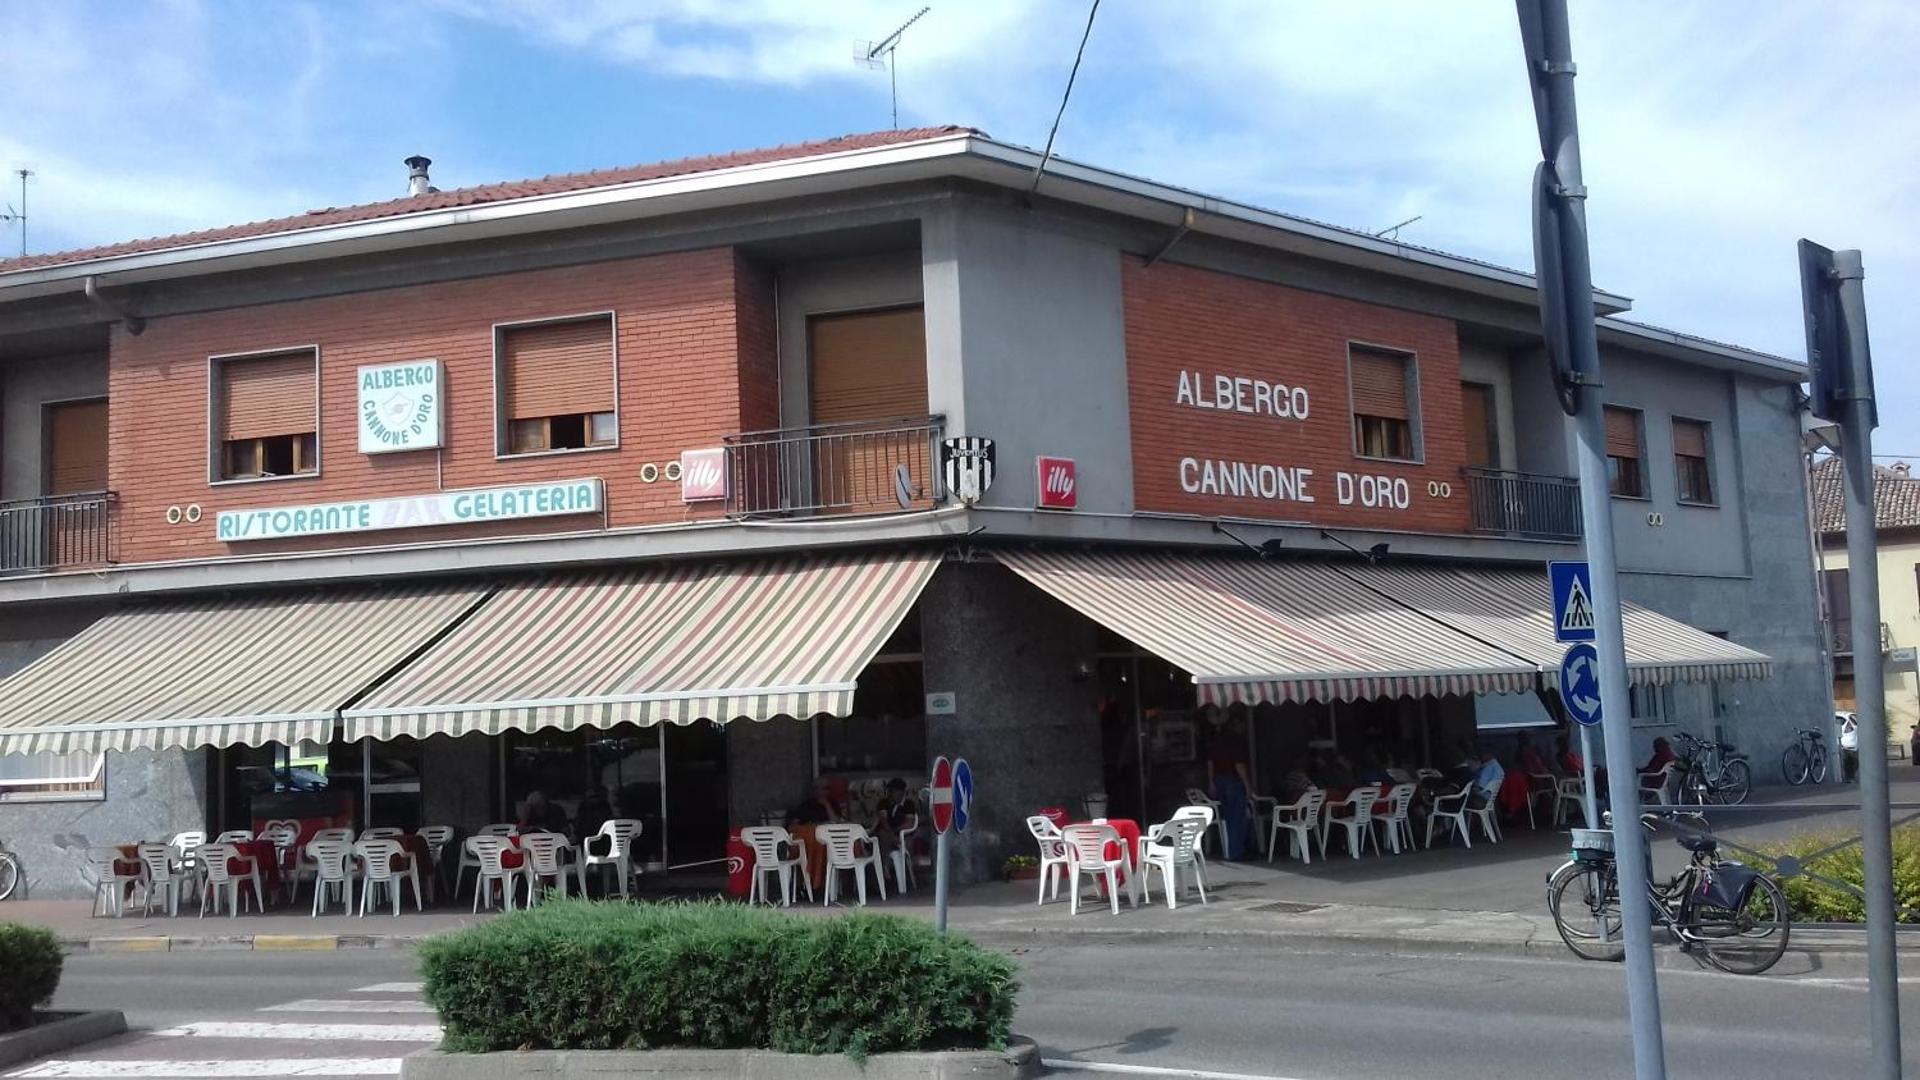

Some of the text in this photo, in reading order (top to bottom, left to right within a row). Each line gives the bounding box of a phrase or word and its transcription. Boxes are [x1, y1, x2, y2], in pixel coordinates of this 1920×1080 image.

[363, 365, 433, 391] ALBERGO
[1177, 370, 1309, 420] ALBERGO
[363, 394, 433, 445] CANNONE D'ORO
[950, 447, 988, 459] JUVENTUS
[687, 460, 721, 492] illy
[1047, 465, 1074, 499] illy
[1180, 457, 1409, 509] CANNONE D'ORO
[219, 484, 592, 538] RISTORANTE BAR GELATERIA
